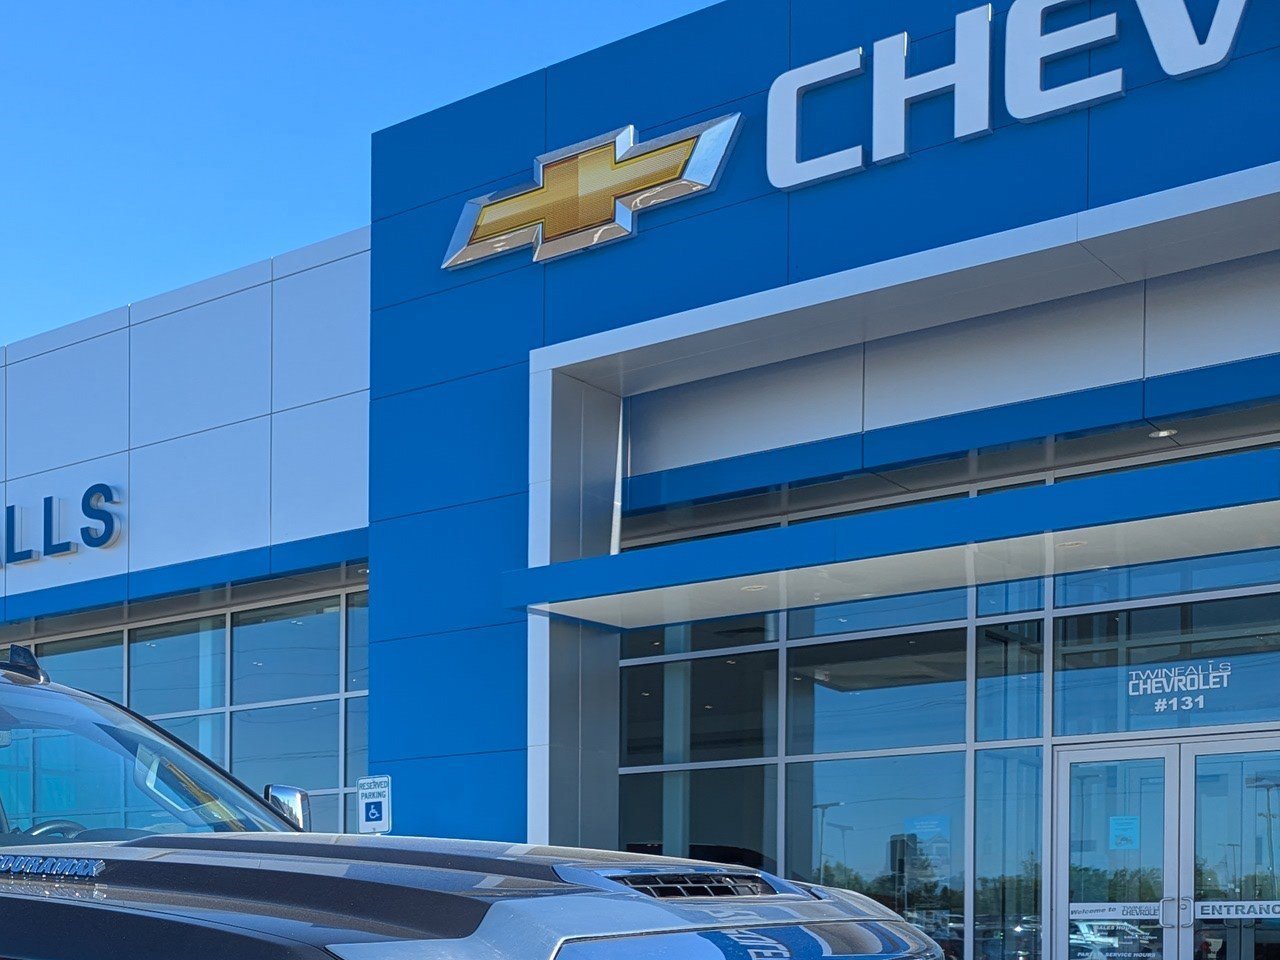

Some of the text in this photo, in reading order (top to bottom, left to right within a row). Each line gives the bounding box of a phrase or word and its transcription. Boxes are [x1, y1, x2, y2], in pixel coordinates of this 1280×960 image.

[766, 0, 1247, 189] CHEV
[1128, 661, 1232, 681] TWINFALLS
[1128, 671, 1232, 696] CHEVROLET
[1154, 694, 1205, 712] #131
[359, 780, 388, 790] RESERVED
[360, 790, 386, 800] PARKING
[1070, 907, 1106, 915] Welcome
